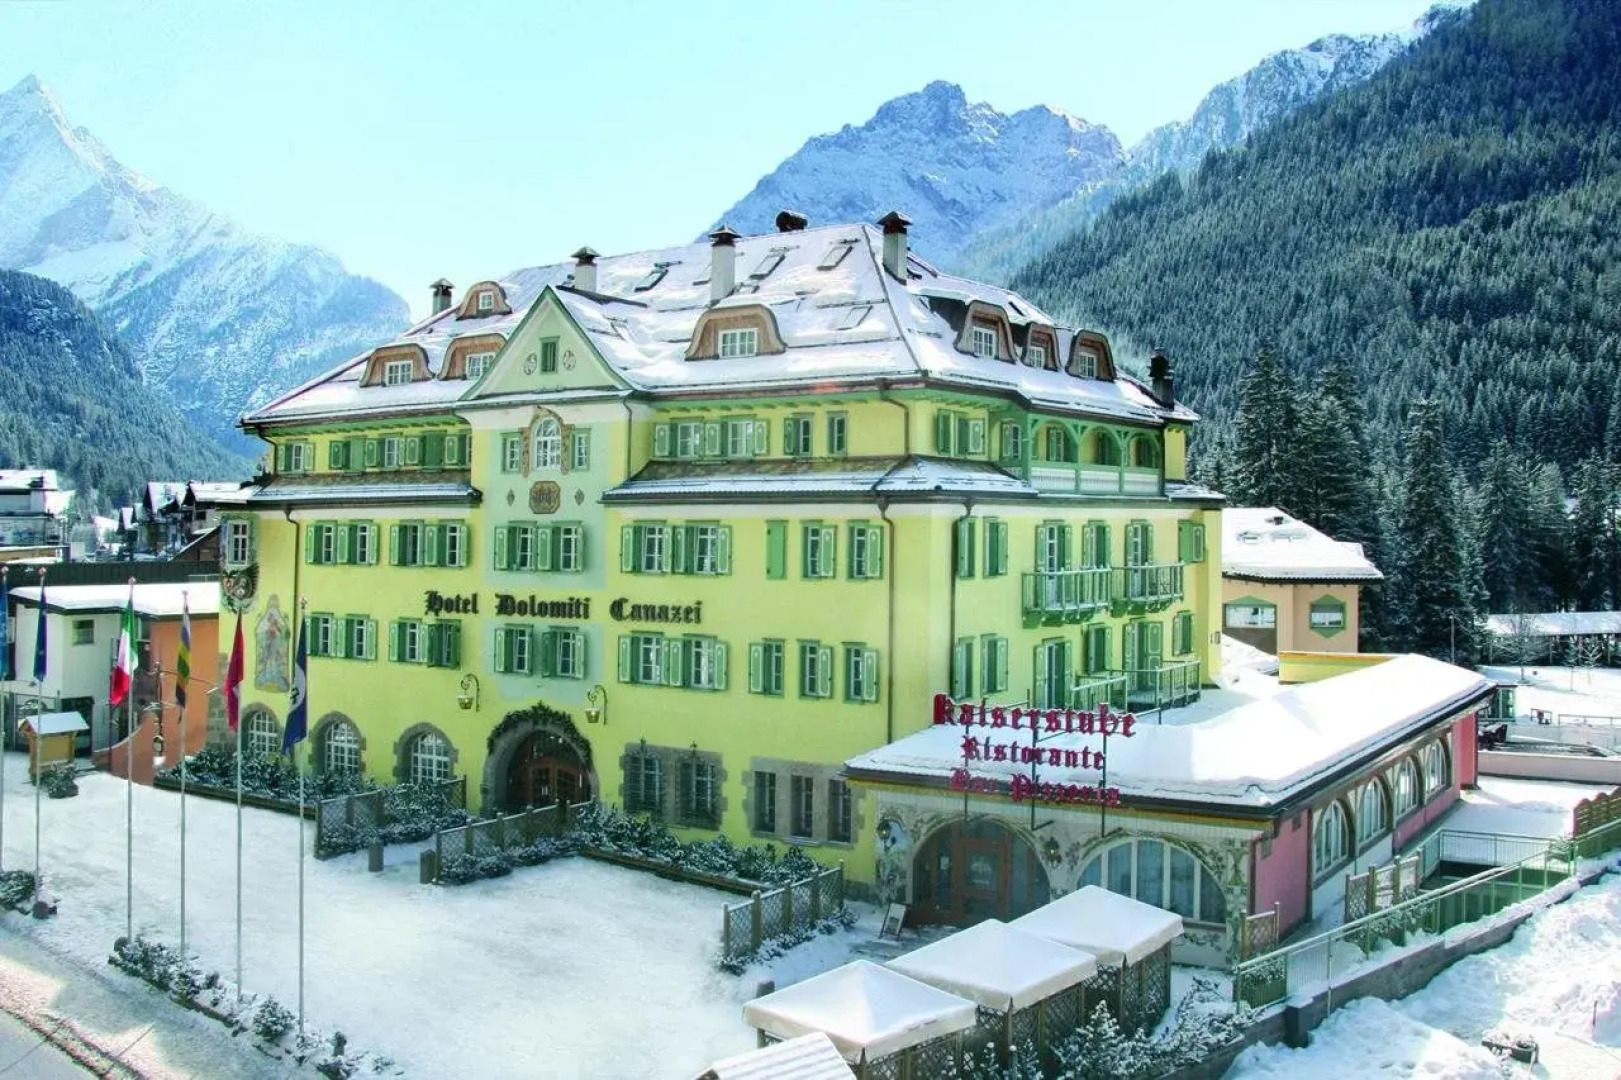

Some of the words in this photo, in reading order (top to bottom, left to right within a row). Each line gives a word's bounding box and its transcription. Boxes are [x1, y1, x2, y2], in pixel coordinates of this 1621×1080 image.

[424, 590, 479, 616] Hotel
[495, 593, 591, 619] Dolomiti
[609, 597, 703, 624] Canazei
[933, 693, 1136, 738] Kaiserstube
[961, 735, 1104, 770] Ristorante
